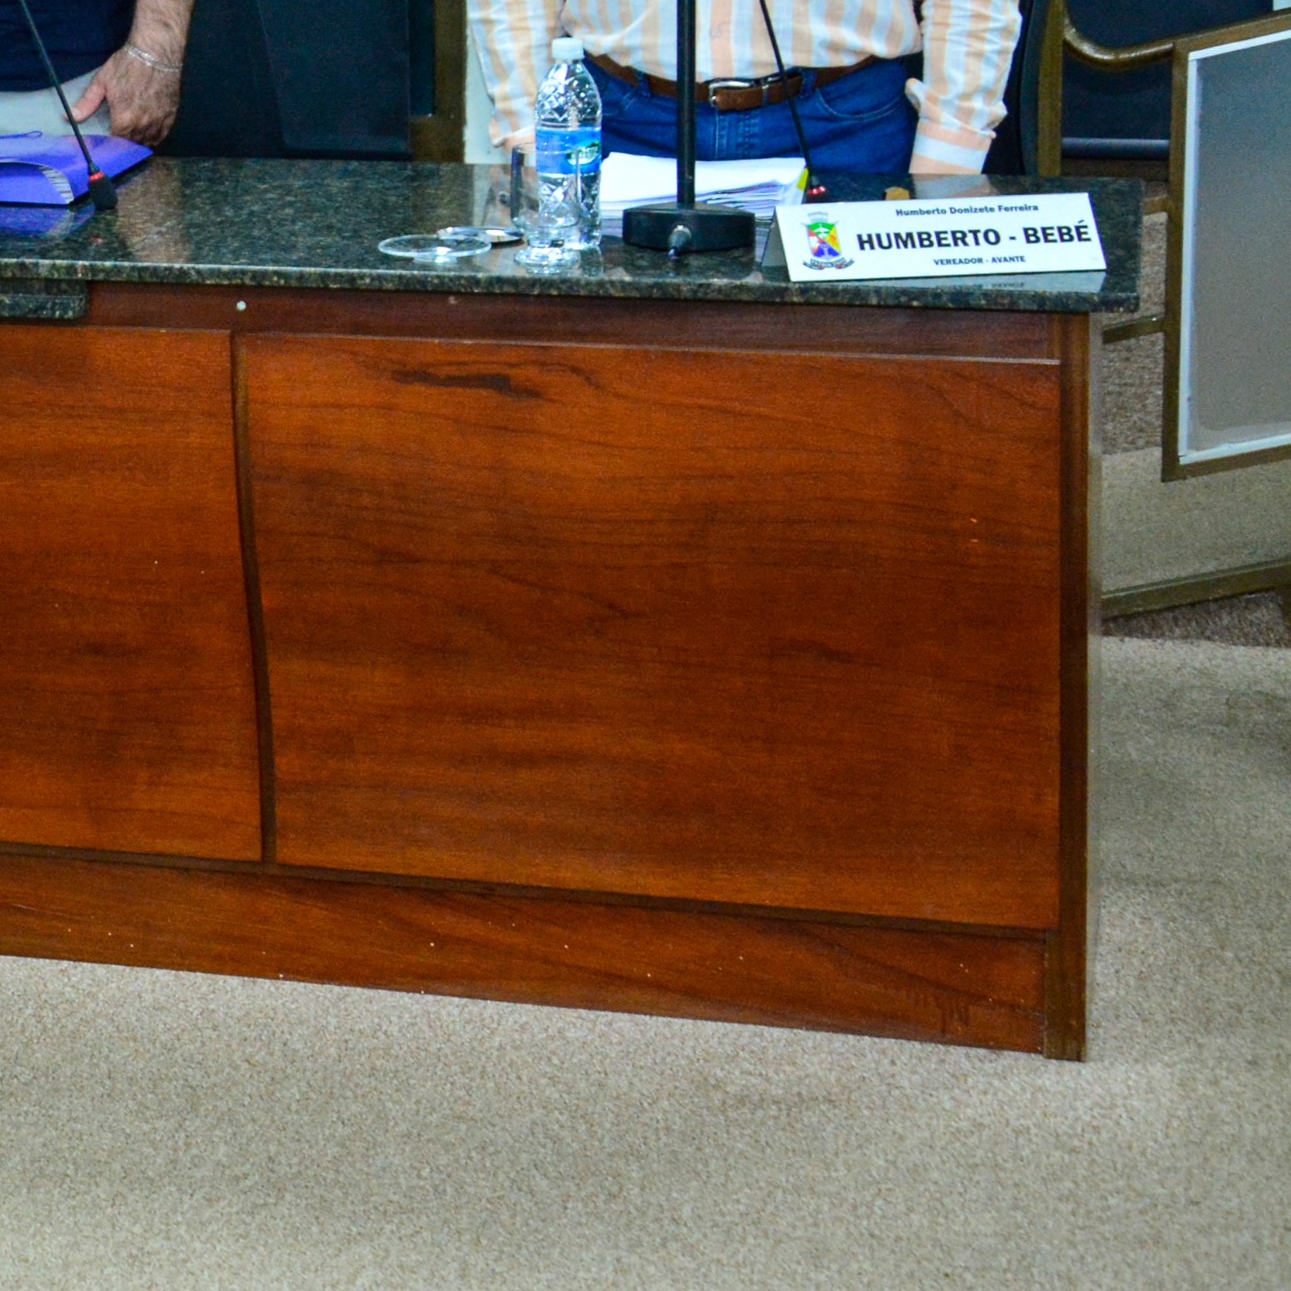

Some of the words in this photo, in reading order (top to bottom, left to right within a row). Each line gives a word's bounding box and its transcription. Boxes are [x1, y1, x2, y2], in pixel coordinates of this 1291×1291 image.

[896, 207, 947, 216] Humberto
[949, 205, 996, 215] Donizete
[997, 203, 1039, 213] Ferreira
[857, 228, 1001, 251] HUMBERTO
[1023, 219, 1092, 244] BEBÉ
[933, 257, 984, 266] VEREADOR
[991, 255, 1026, 264] AVANTE
